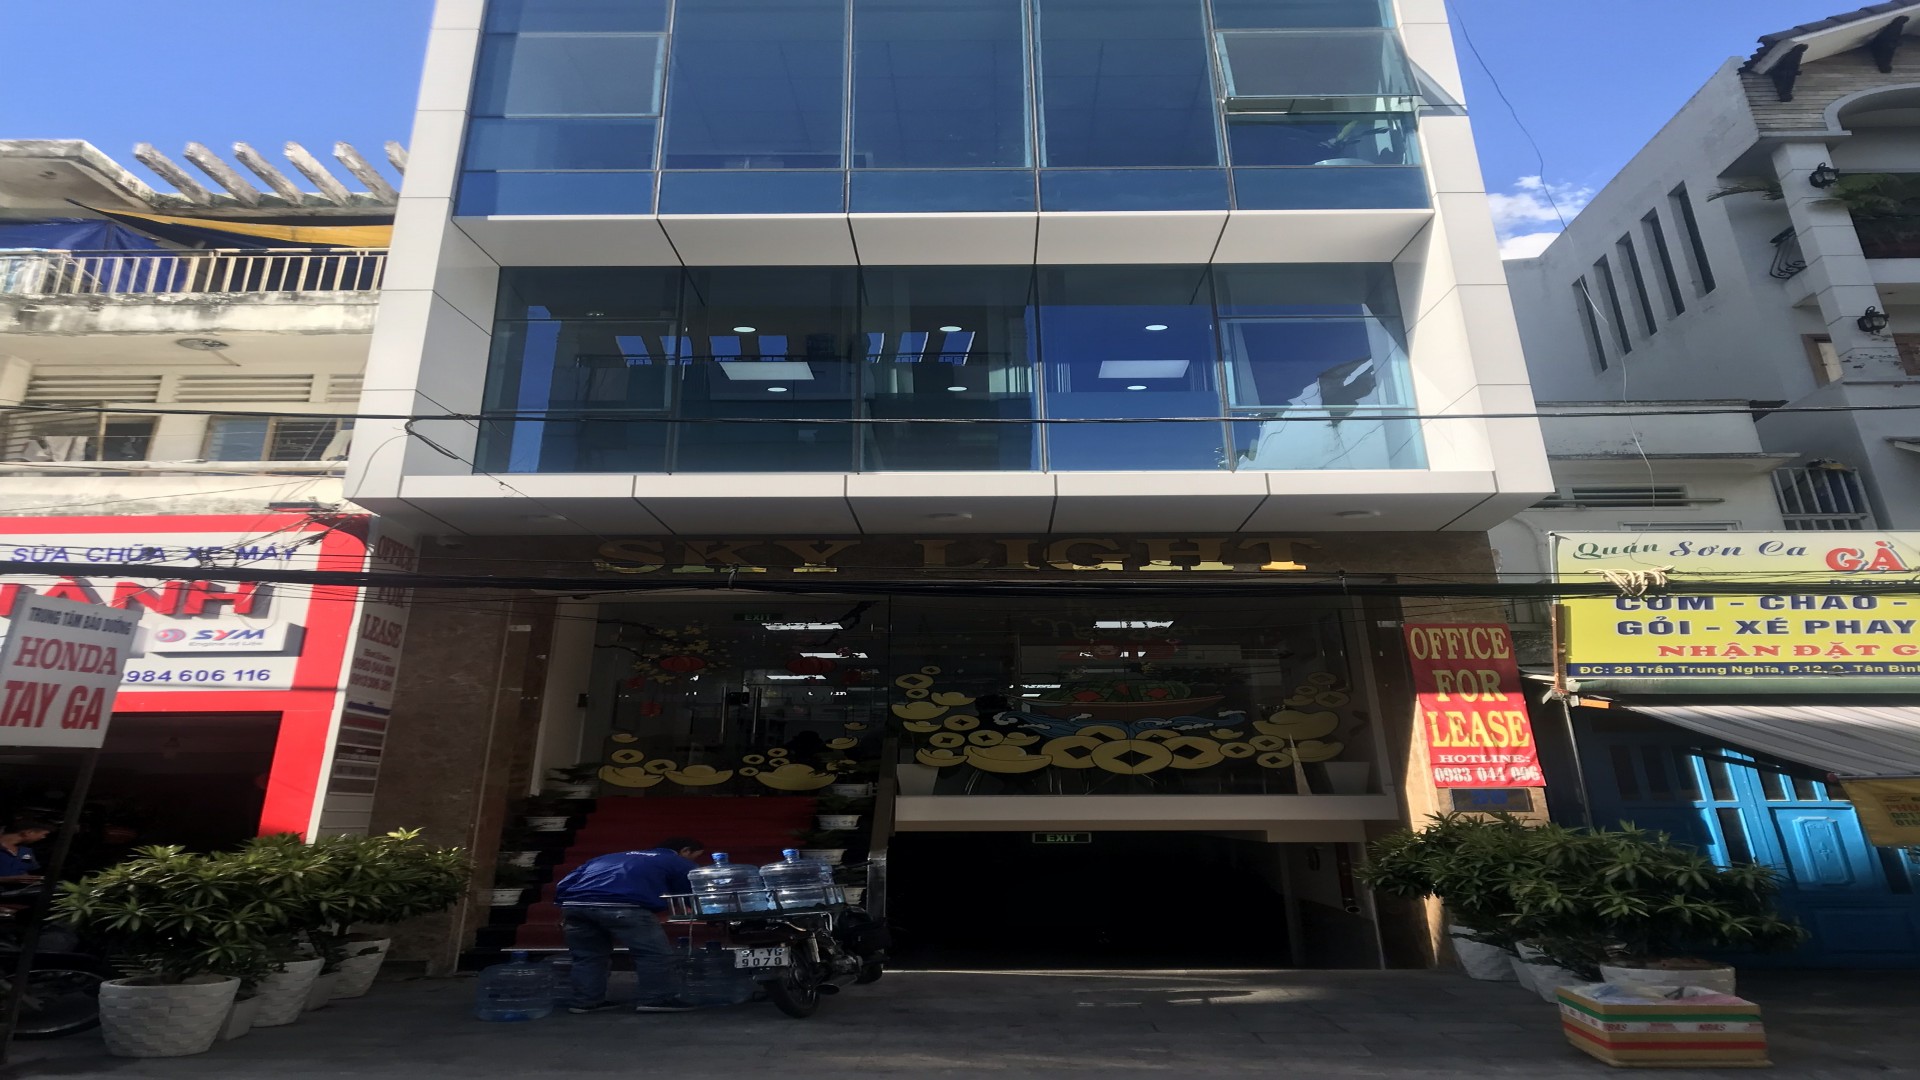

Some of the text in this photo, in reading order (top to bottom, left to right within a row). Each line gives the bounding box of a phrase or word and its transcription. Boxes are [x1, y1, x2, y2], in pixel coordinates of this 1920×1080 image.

[592, 536, 1324, 574] SKY LIGHT
[1573, 540, 1810, 560] Quán Sơn Ca
[0, 574, 259, 615] ÀNH
[188, 628, 265, 641] SYM
[1616, 616, 1691, 635] GỎI
[1735, 617, 1790, 635] XÉ
[1804, 619, 1917, 635] PHAY
[1409, 627, 1510, 661] OFFICE
[1657, 641, 1782, 660] NHẬN
[1793, 641, 1881, 660] ĐẶT
[13, 635, 119, 676] HONDA
[122, 669, 271, 683] 984 606 116
[1614, 665, 1633, 674] 28
[1678, 665, 1727, 676] Trung
[1852, 664, 1884, 673] Tân
[1432, 669, 1509, 703] FOR
[0, 680, 106, 730] TAY GA
[1427, 710, 1531, 748] LEASE
[1438, 754, 1531, 763] HOTLINE:
[1434, 767, 1473, 782] 0983
[1476, 766, 1506, 782] 044
[1046, 833, 1078, 842] EXIT
